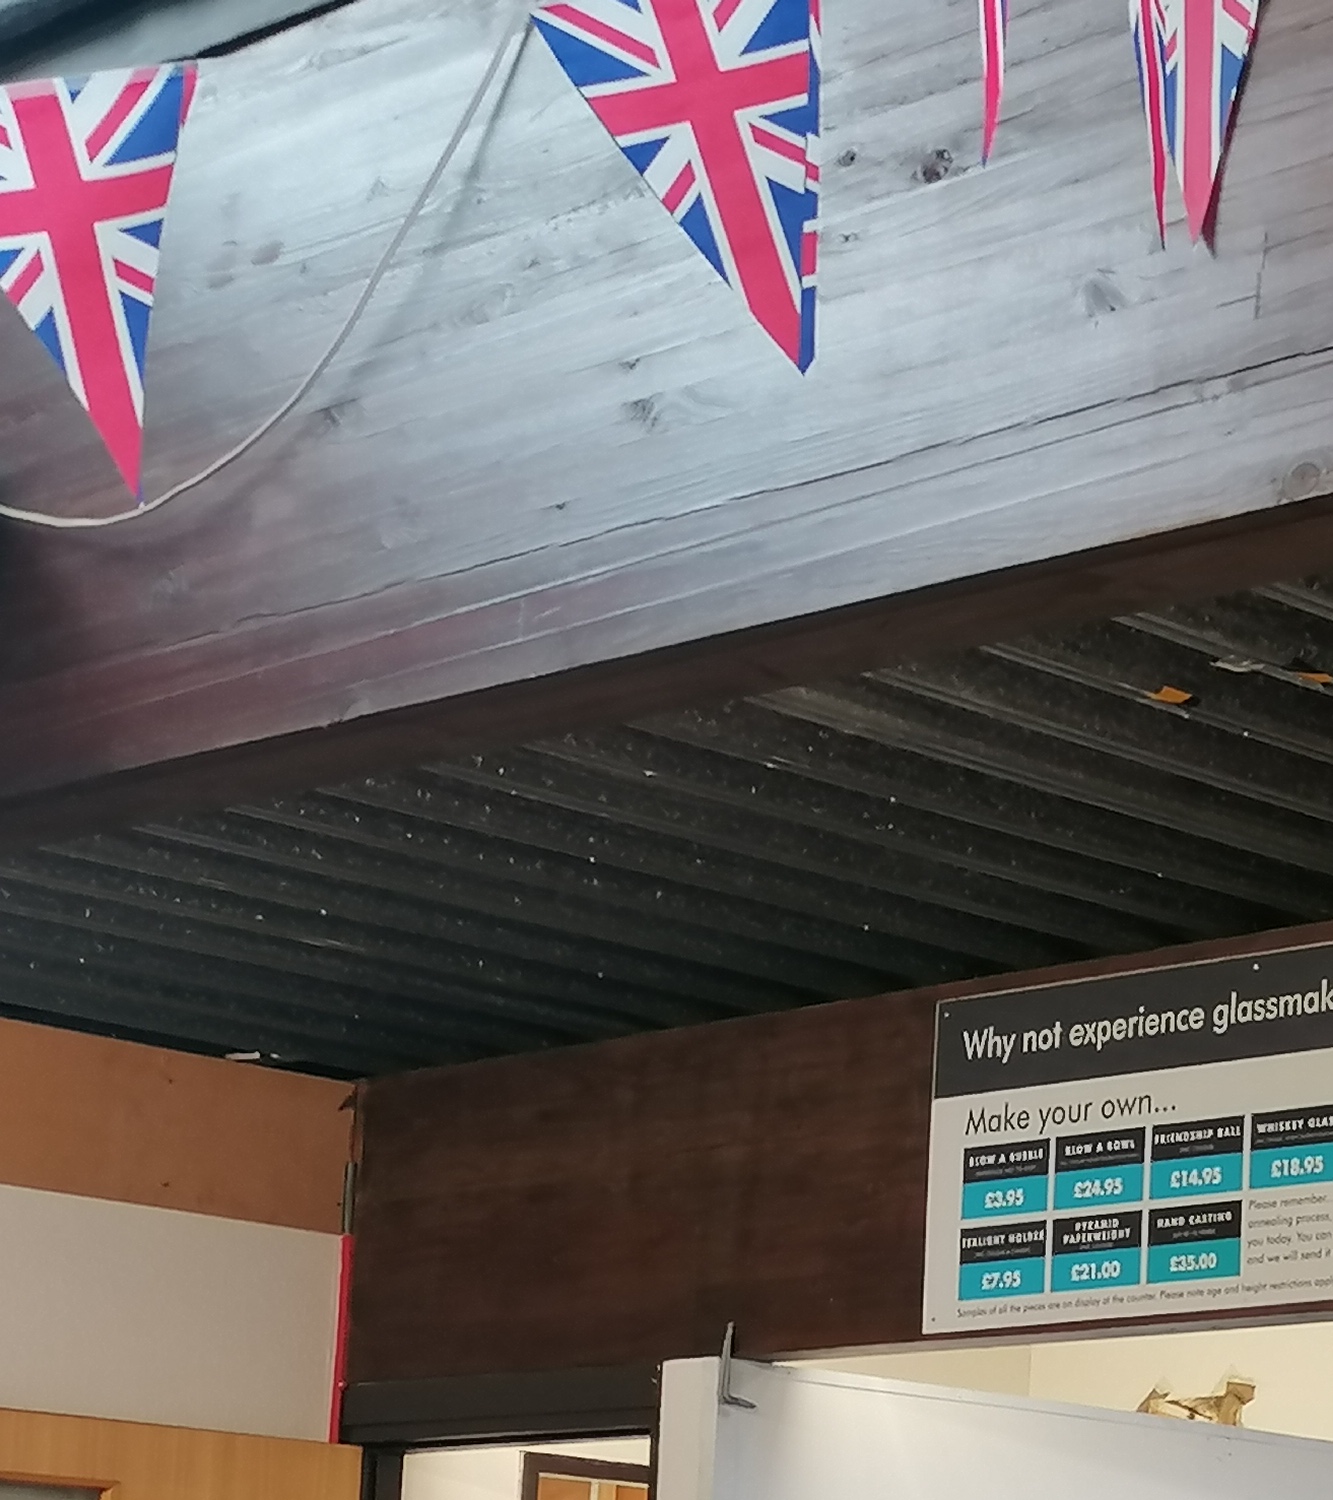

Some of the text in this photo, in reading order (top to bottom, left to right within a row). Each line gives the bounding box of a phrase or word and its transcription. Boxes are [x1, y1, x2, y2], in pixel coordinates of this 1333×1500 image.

[963, 1026, 1016, 1064] Why
[1022, 1021, 1063, 1053] not
[1069, 1005, 1204, 1051] experience
[965, 1093, 1177, 1135] Make your own...
[1096, 1142, 1104, 1153] A
[997, 1152, 1007, 1165] A
[1270, 1155, 1325, 1178] £18.95
[1169, 1167, 1222, 1189] £14.95
[1248, 1199, 1278, 1210] Please
[1247, 1238, 1264, 1248] you
[1296, 1232, 1314, 1243] You
[1315, 1231, 1333, 1241] can
[1169, 1252, 1218, 1273] £35.00
[1247, 1253, 1266, 1265] and
[981, 1269, 1021, 1291] £7.95
[1070, 1260, 1121, 1283] £21.00
